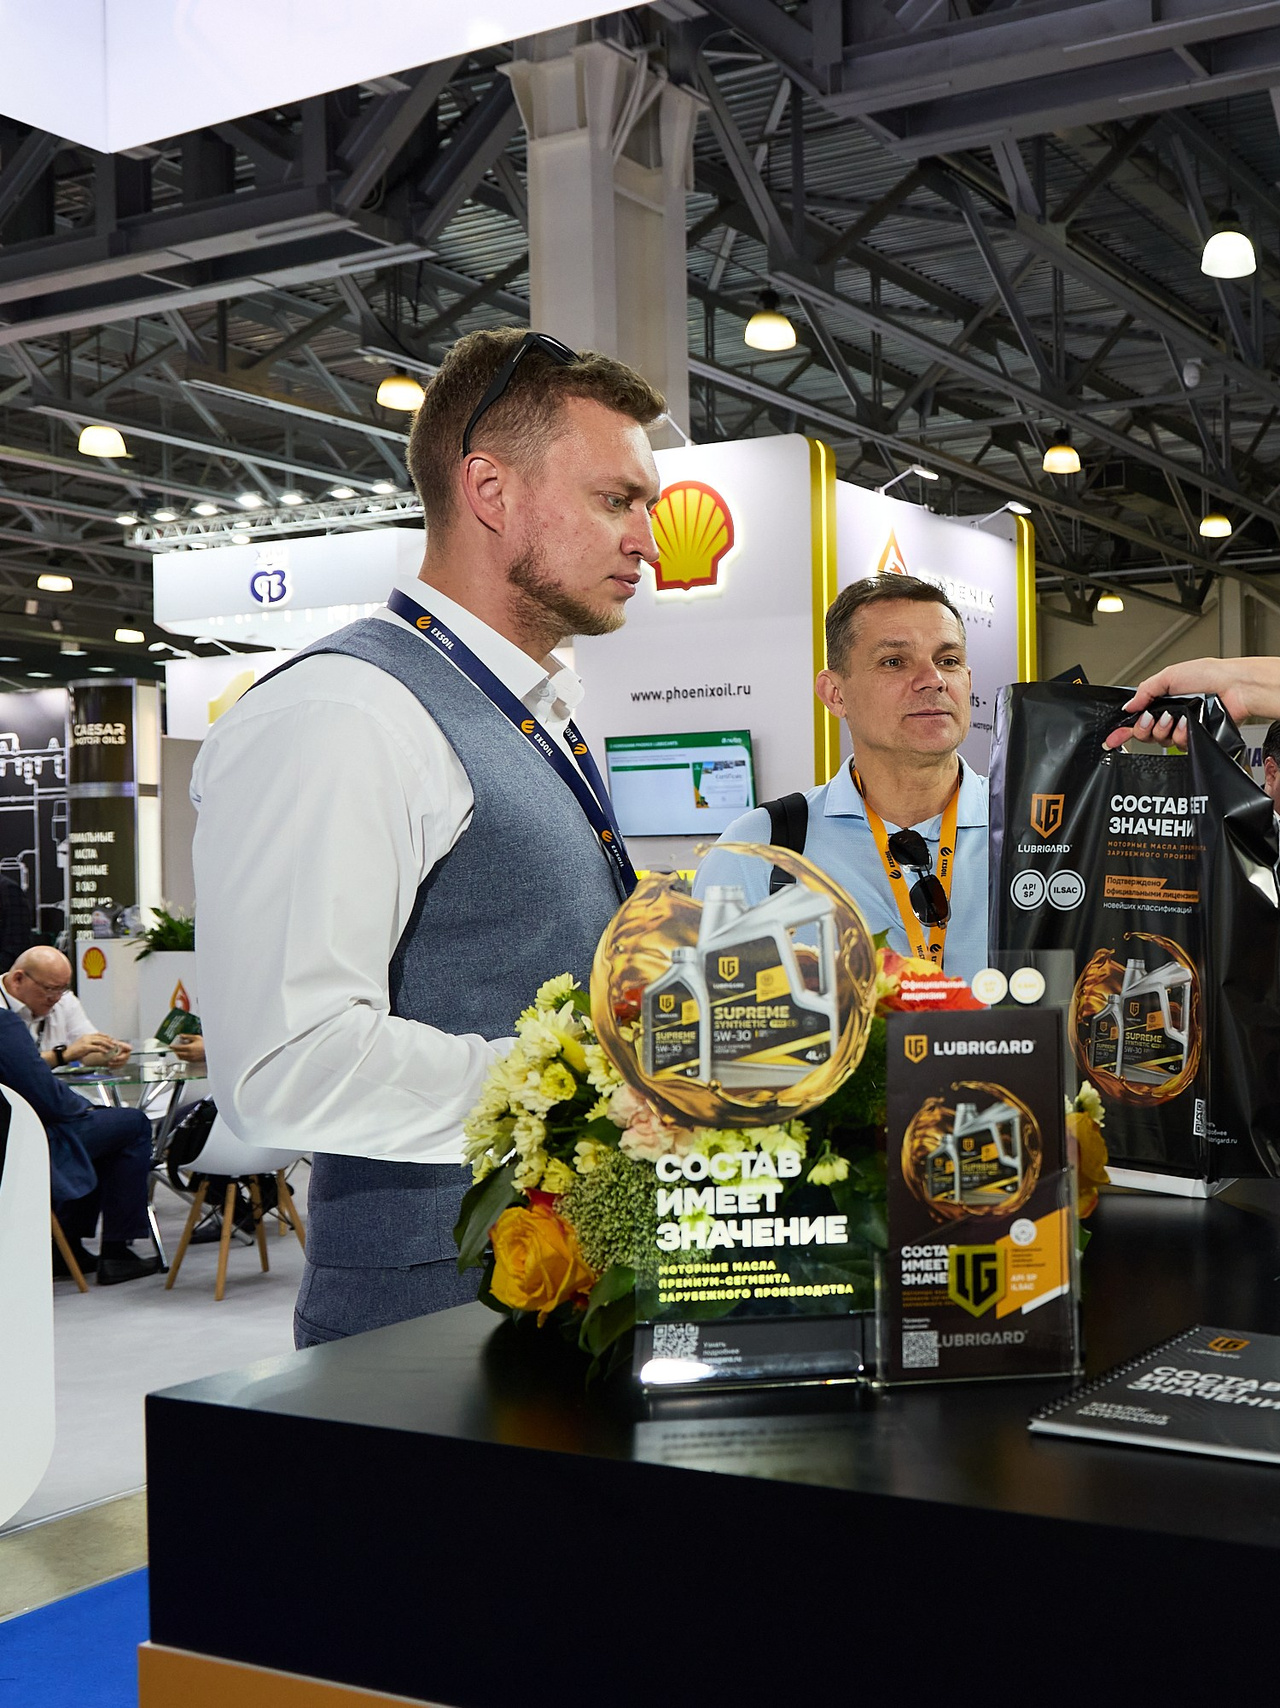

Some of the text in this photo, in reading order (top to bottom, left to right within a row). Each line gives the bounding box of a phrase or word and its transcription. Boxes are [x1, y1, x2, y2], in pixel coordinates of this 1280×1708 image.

[430, 627, 455, 651] EXSOIL
[630, 682, 751, 703] www.phoenixoil.ru
[74, 722, 127, 738] CAESAR
[565, 726, 579, 744] EXSO
[101, 736, 127, 745] OILS
[533, 732, 554, 757] EXSOIL
[1110, 794, 1189, 815] СОСТАВ
[1108, 816, 1195, 838] ЗНАЧЕНИ
[1017, 843, 1071, 854] LUBRIGARD
[1107, 841, 1147, 849] МОТОРНЫЕ
[1150, 843, 1177, 851] МАСЛА
[1107, 850, 1161, 859] ЗАРУБЕЖНОГО
[1022, 883, 1037, 891] API
[1106, 876, 1161, 887] Подтверждено
[1053, 886, 1078, 894] ILSAC
[1105, 888, 1161, 897] официальными
[1103, 901, 1193, 914] новейших классификаций
[713, 1005, 790, 1020] SUPREME
[713, 1019, 768, 1030] SYNTHETIC
[655, 1031, 697, 1041] SUPREME
[713, 1030, 752, 1042] 5W-30
[1125, 1031, 1163, 1043] SUPREME
[933, 1039, 1035, 1056] LUBRIGARD
[655, 1150, 802, 1183] СОСТАВ
[655, 1183, 784, 1217] ИМЕЕТ
[655, 1215, 849, 1251] ЗНАЧЕНИЕ
[900, 1244, 957, 1259] СОСТА
[658, 1260, 777, 1276] МОТОРНЫЕ МАСЛА
[658, 1273, 791, 1290] ПРЕМИУМ-СЕГМЕНТА
[900, 1271, 949, 1286] ЗНАЧЕ
[658, 1283, 855, 1303] ЗАРУБЕЖНОГО ПРОИЗВОДСТВА
[934, 1329, 1026, 1349] LUBRIGARD
